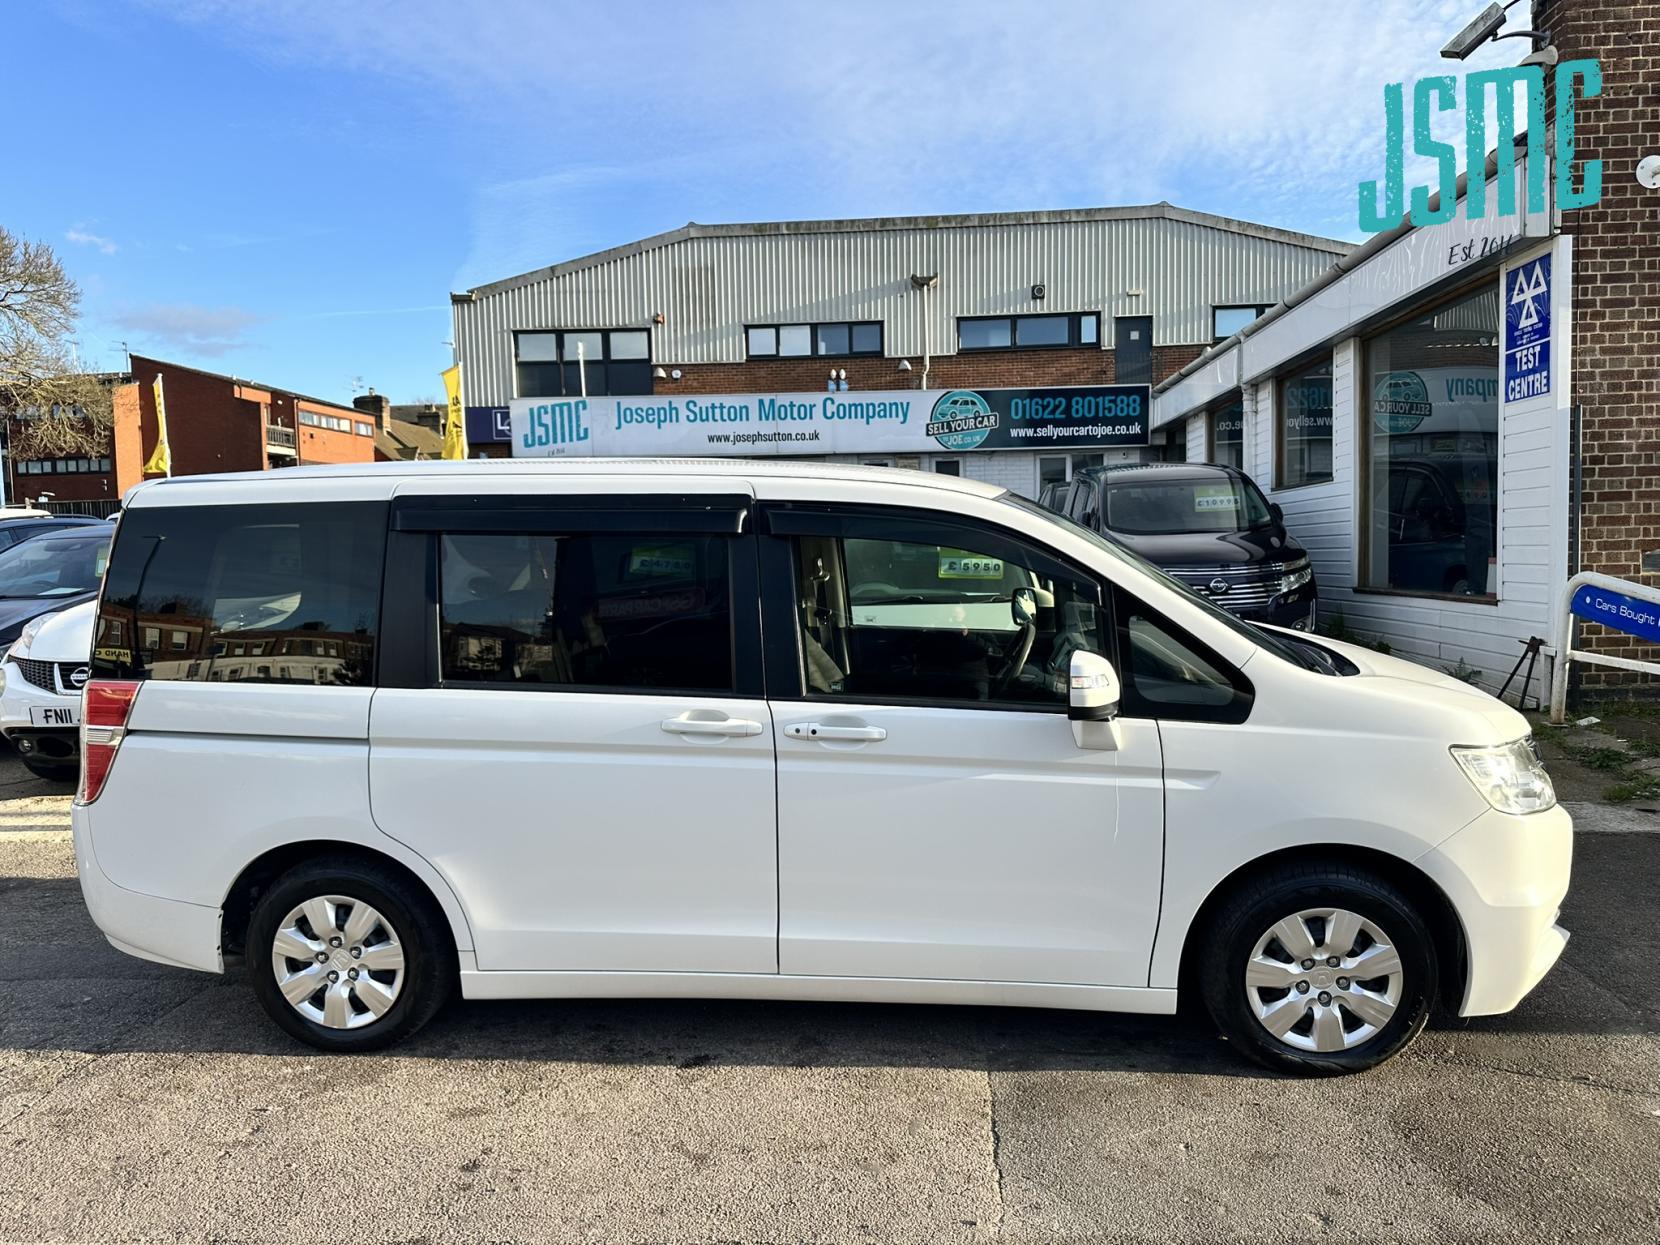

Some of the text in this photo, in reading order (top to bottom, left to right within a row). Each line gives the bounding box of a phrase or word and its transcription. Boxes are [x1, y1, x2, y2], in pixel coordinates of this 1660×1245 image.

[1515, 345, 1541, 372] TEST
[1508, 371, 1548, 400] CENTRE
[615, 396, 910, 430] Joseph Sutton Motor Company
[1010, 395, 1140, 420] 01622 801588
[523, 400, 589, 448] JSMC
[928, 415, 996, 435] SELL YOUR CAR
[1010, 421, 1141, 440] www.sellyourcartojoe.co.uk
[707, 429, 820, 446] www.josephsutton.co.uk
[948, 561, 1000, 572] £5950
[1595, 598, 1616, 613] Cars
[1619, 605, 1655, 625] Bought
